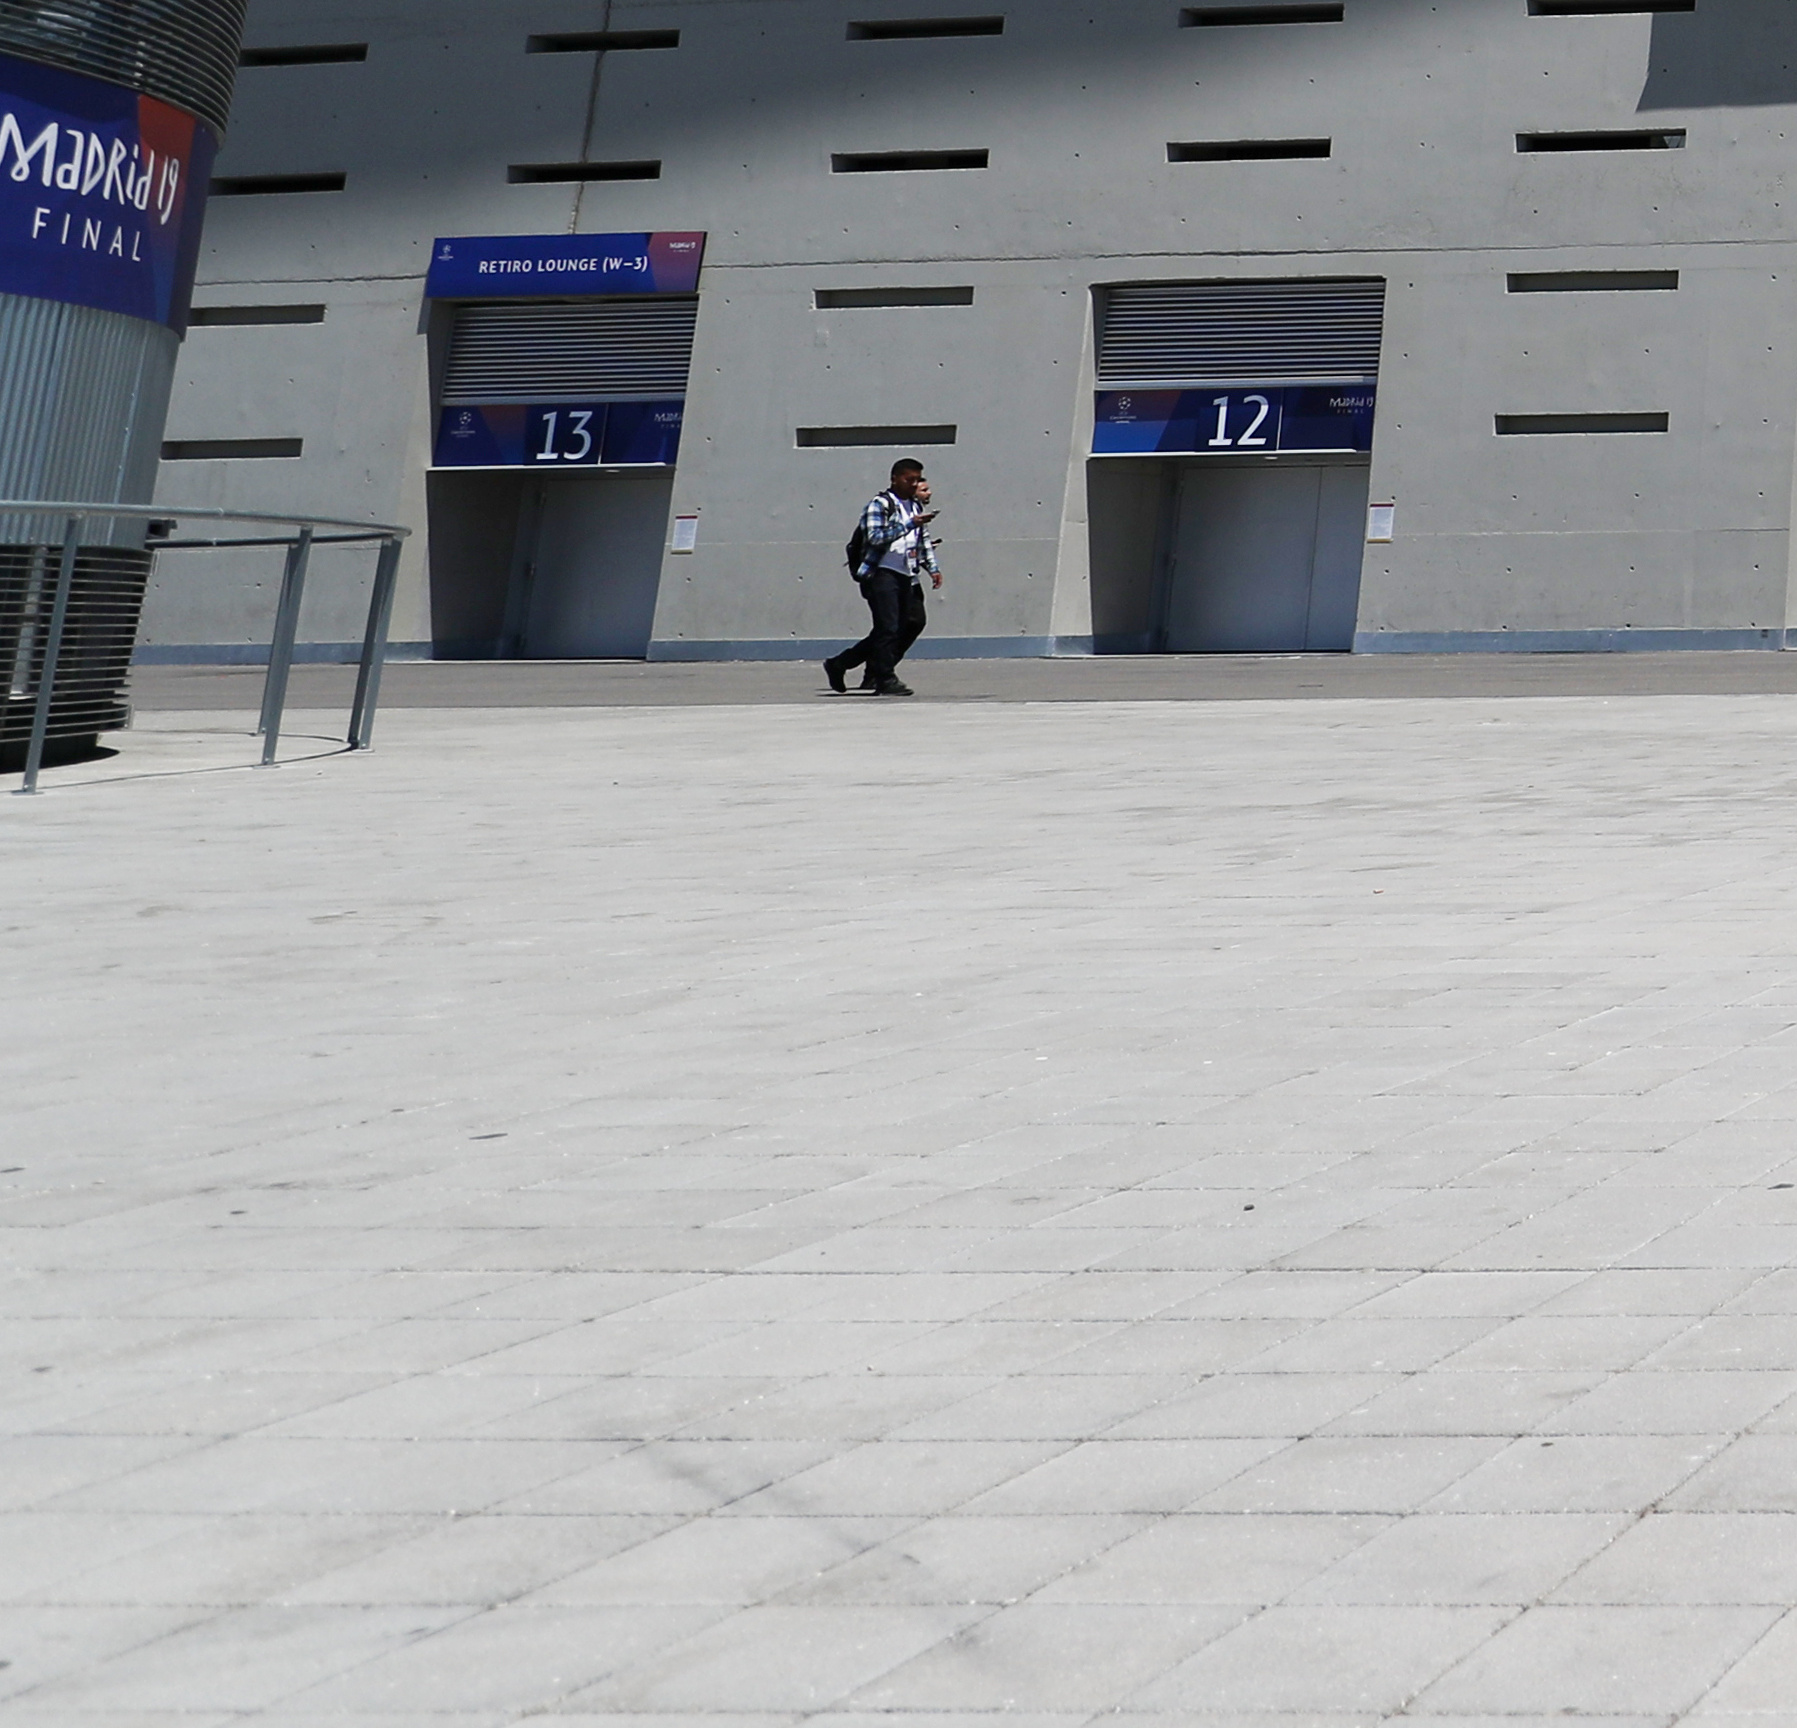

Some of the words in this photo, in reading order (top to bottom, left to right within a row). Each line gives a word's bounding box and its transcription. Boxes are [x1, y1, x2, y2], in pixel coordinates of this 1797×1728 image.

[158, 156, 180, 225] 19
[32, 206, 141, 262] FINAL
[479, 259, 533, 273] RETIRO
[537, 258, 598, 272] LOUNGE
[536, 411, 594, 460] 13
[1208, 394, 1269, 446] 12
